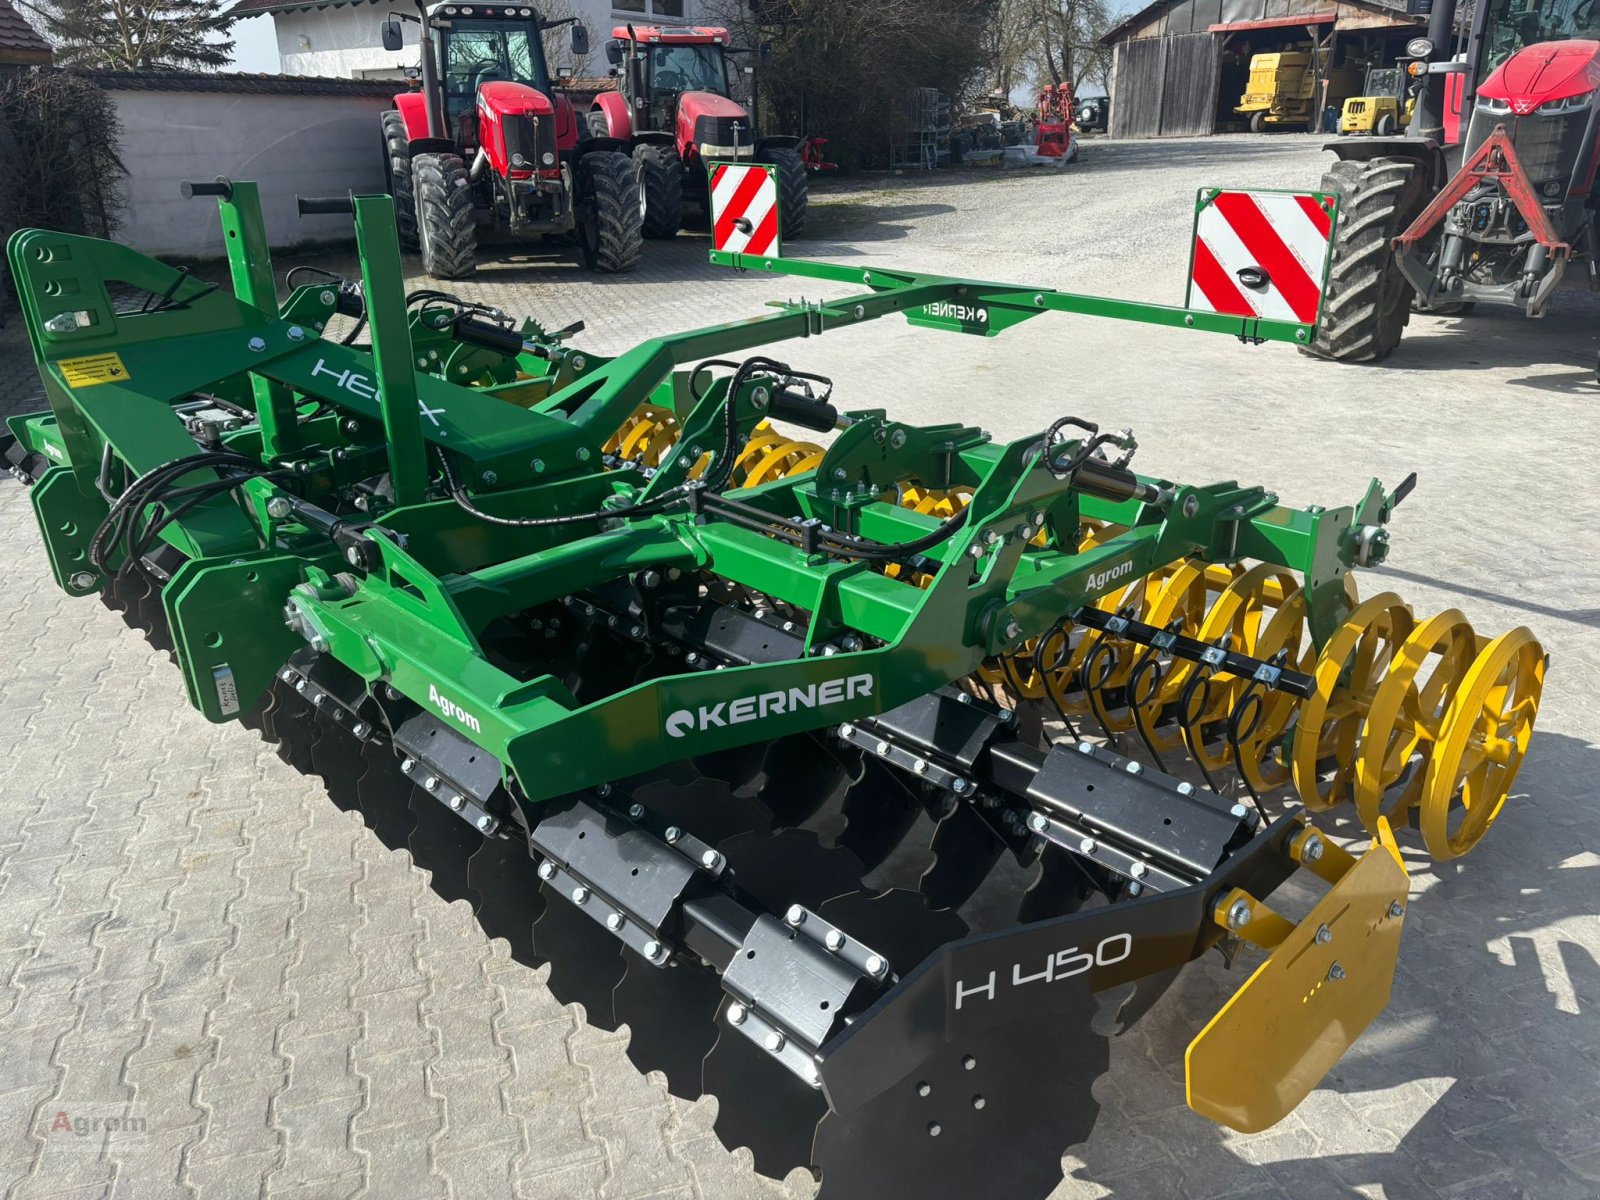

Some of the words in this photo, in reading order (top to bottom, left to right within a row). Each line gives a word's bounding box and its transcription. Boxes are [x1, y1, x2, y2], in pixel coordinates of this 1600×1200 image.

[311, 358, 447, 427] HEX
[1084, 559, 1133, 593] Agrom
[428, 683, 481, 734] Agrom
[698, 673, 874, 732] KERNER
[955, 970, 996, 1010] H
[1012, 932, 1132, 986] 450
